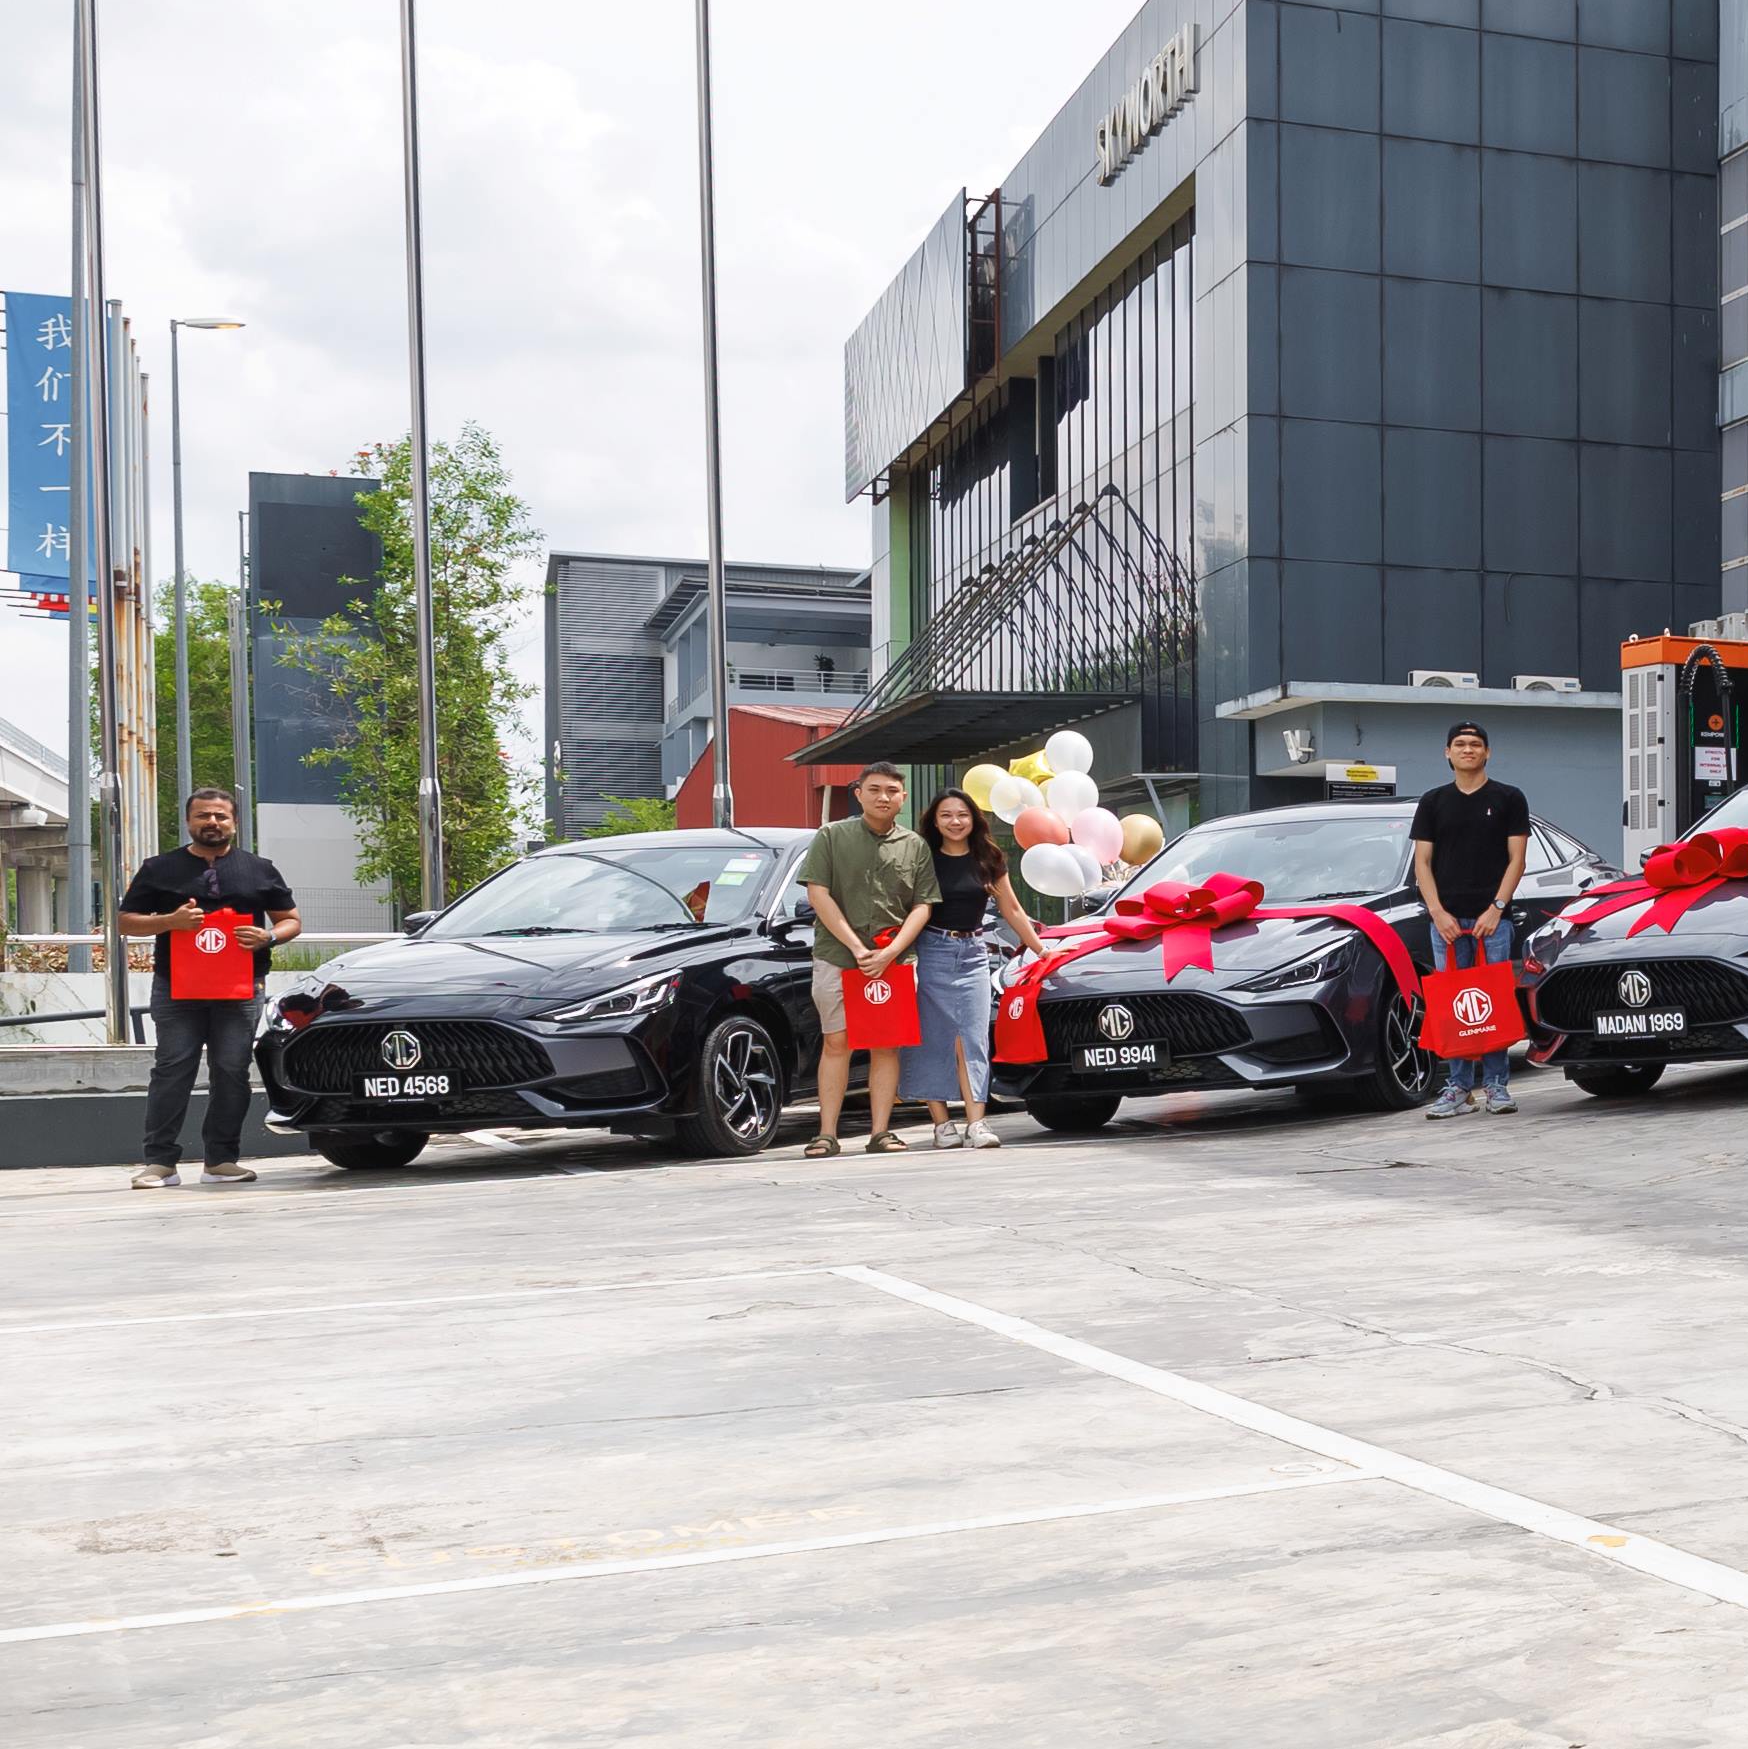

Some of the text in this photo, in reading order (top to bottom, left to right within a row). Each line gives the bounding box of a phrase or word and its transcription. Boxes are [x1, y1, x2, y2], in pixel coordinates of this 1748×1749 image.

[198, 930, 225, 951] MG
[866, 982, 890, 1003] MG
[1621, 974, 1648, 1004] MG
[1456, 991, 1489, 1022] MG
[1101, 1008, 1130, 1036] MG
[1597, 1013, 1684, 1034] MADANI 1969
[385, 1034, 416, 1065] MG
[1084, 1044, 1156, 1067] NED 9941
[364, 1075, 449, 1097] NED 4568
